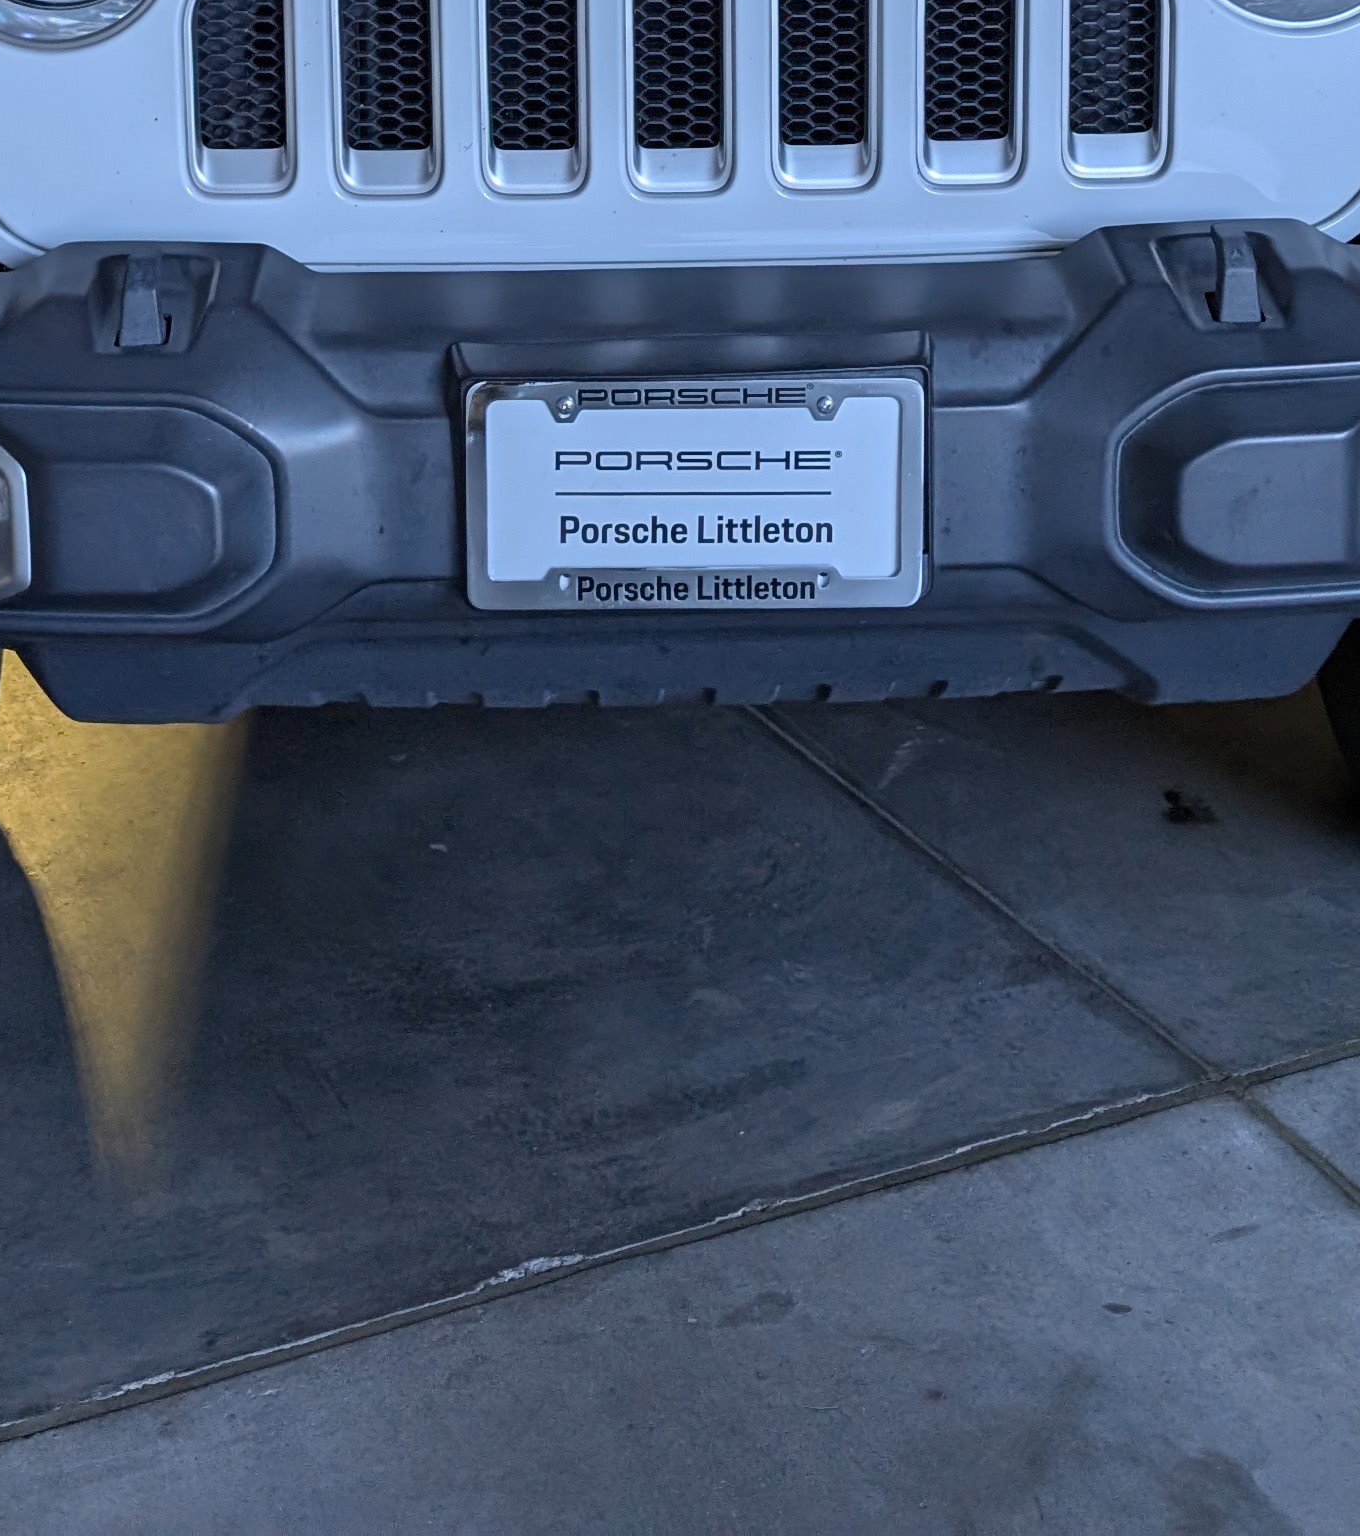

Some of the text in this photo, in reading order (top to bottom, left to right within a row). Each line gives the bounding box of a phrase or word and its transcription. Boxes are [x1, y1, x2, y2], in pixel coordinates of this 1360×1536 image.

[559, 515, 833, 544] Porsche Littleton
[577, 575, 816, 602] Porsche Littleton
